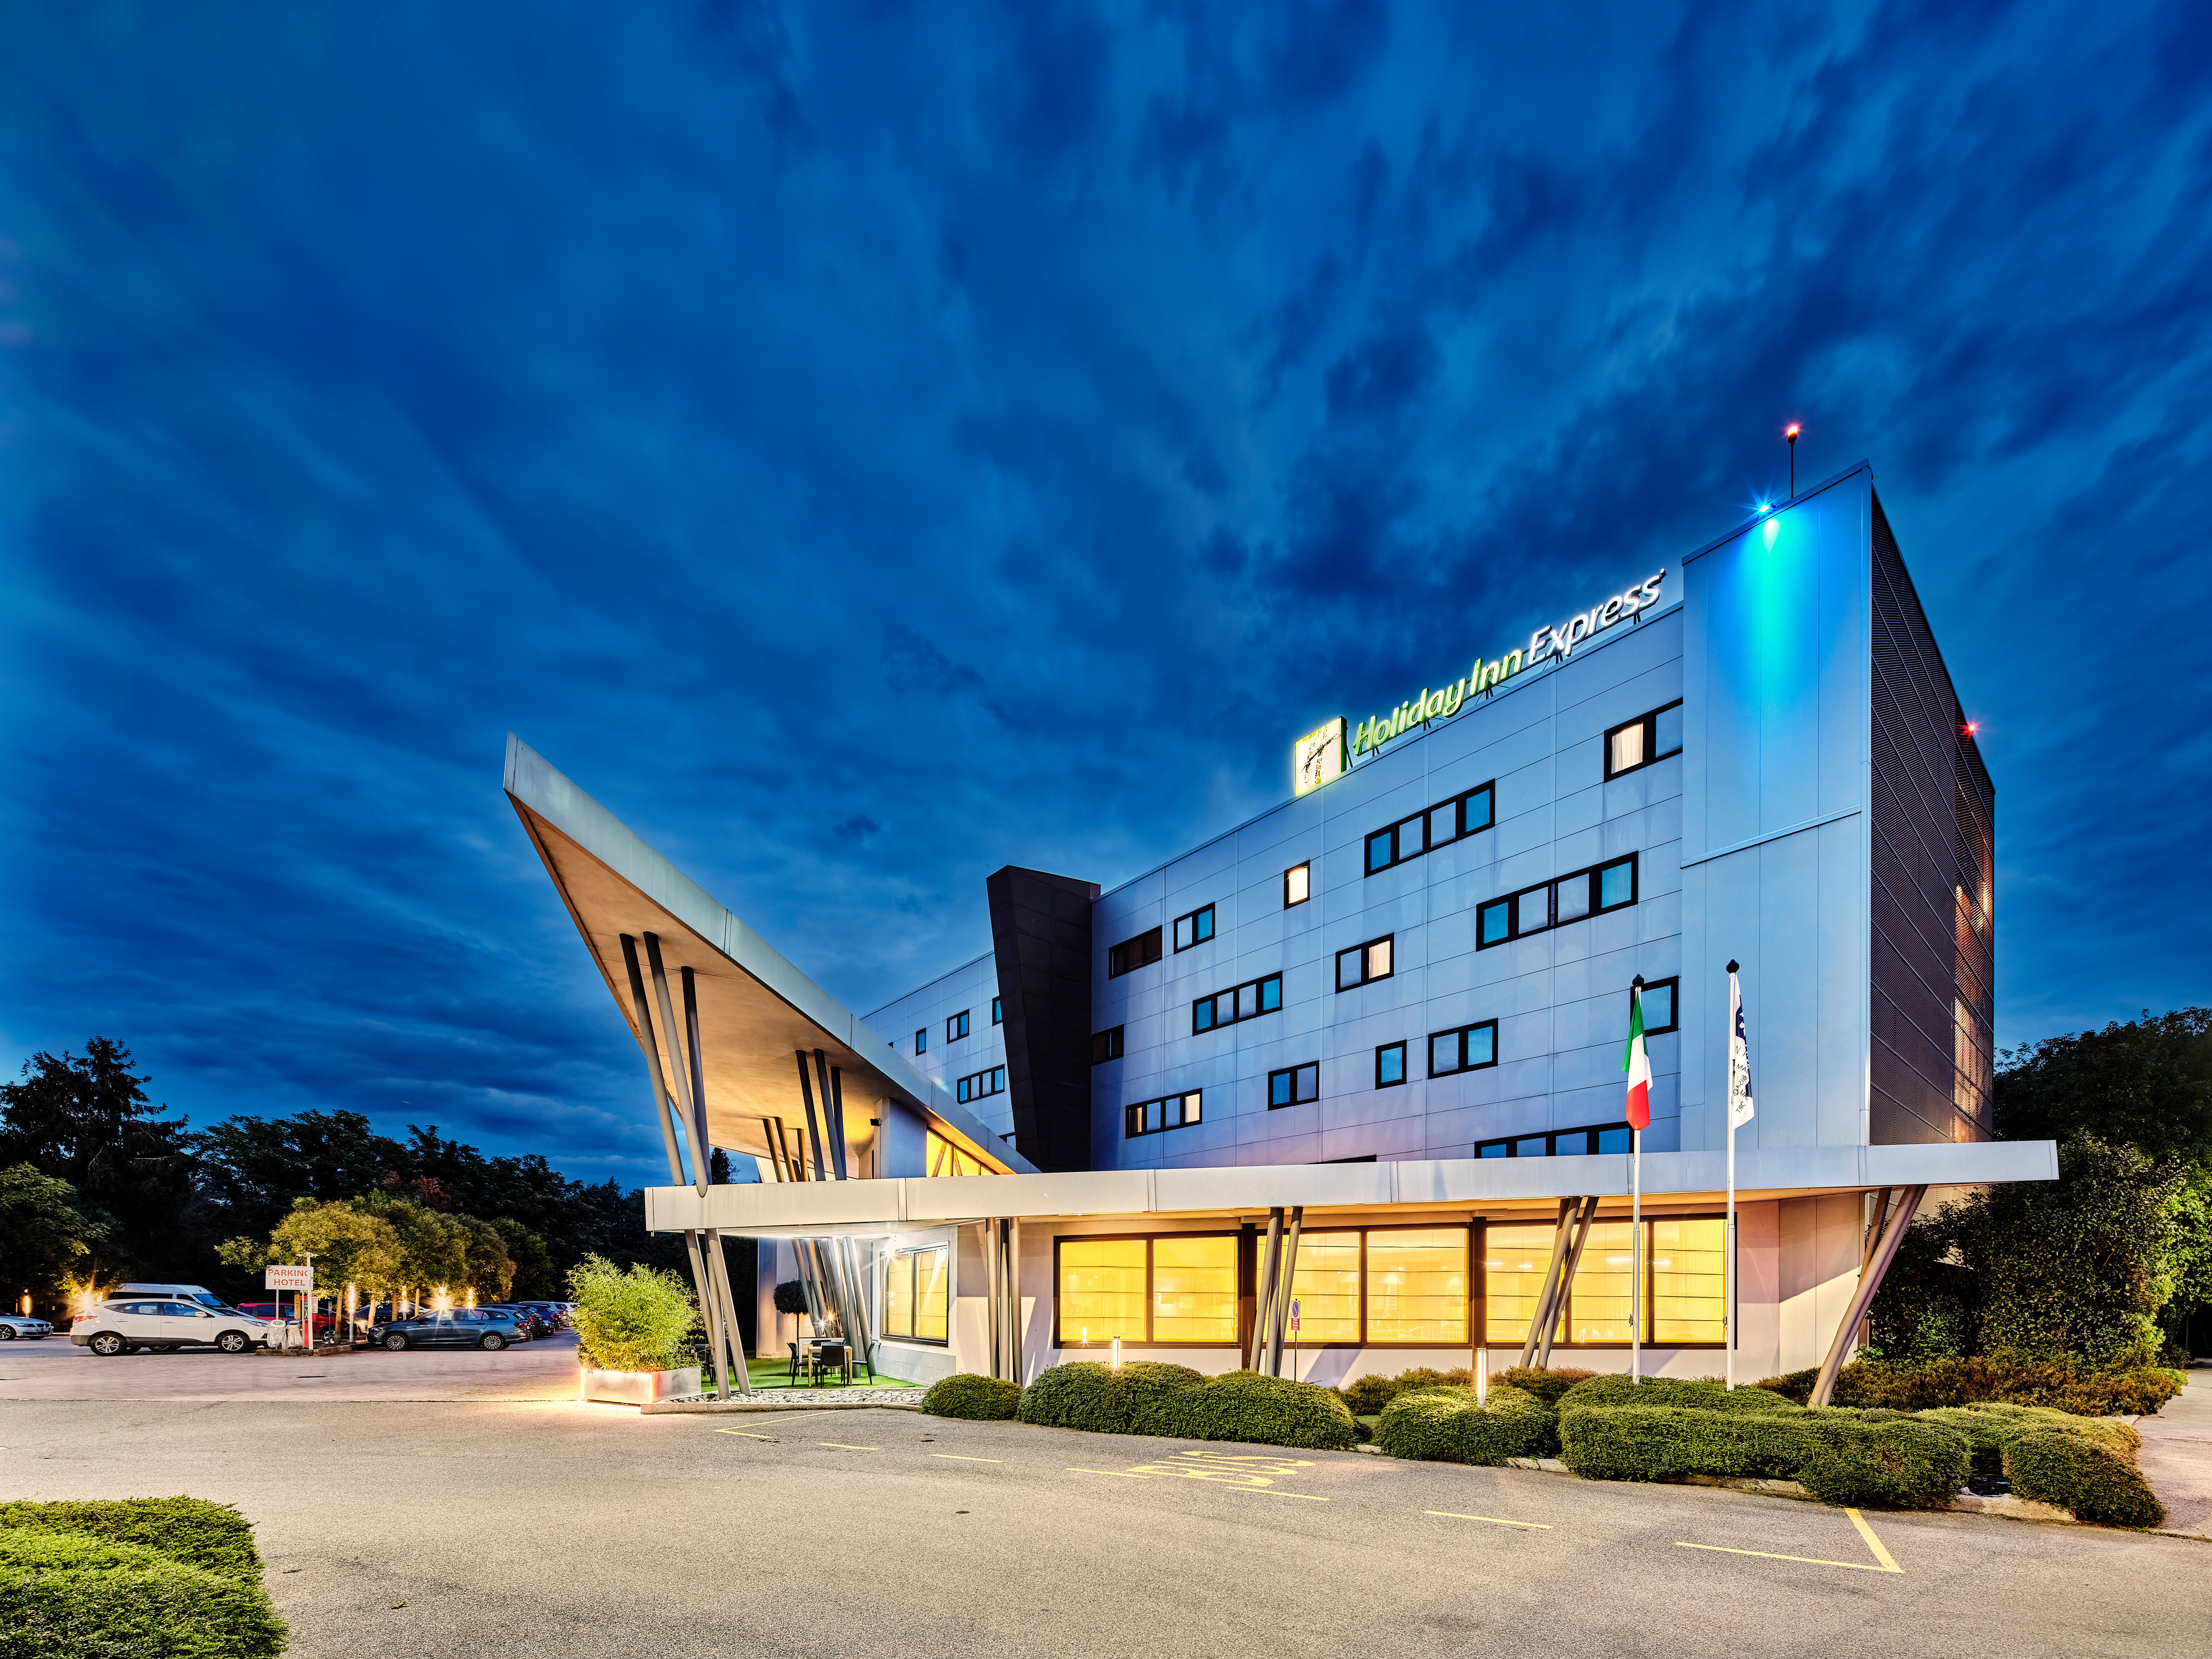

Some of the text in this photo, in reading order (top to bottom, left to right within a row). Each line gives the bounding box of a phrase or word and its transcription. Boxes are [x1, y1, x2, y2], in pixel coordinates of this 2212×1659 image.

[1353, 575, 1660, 756] Holiday Inn Express
